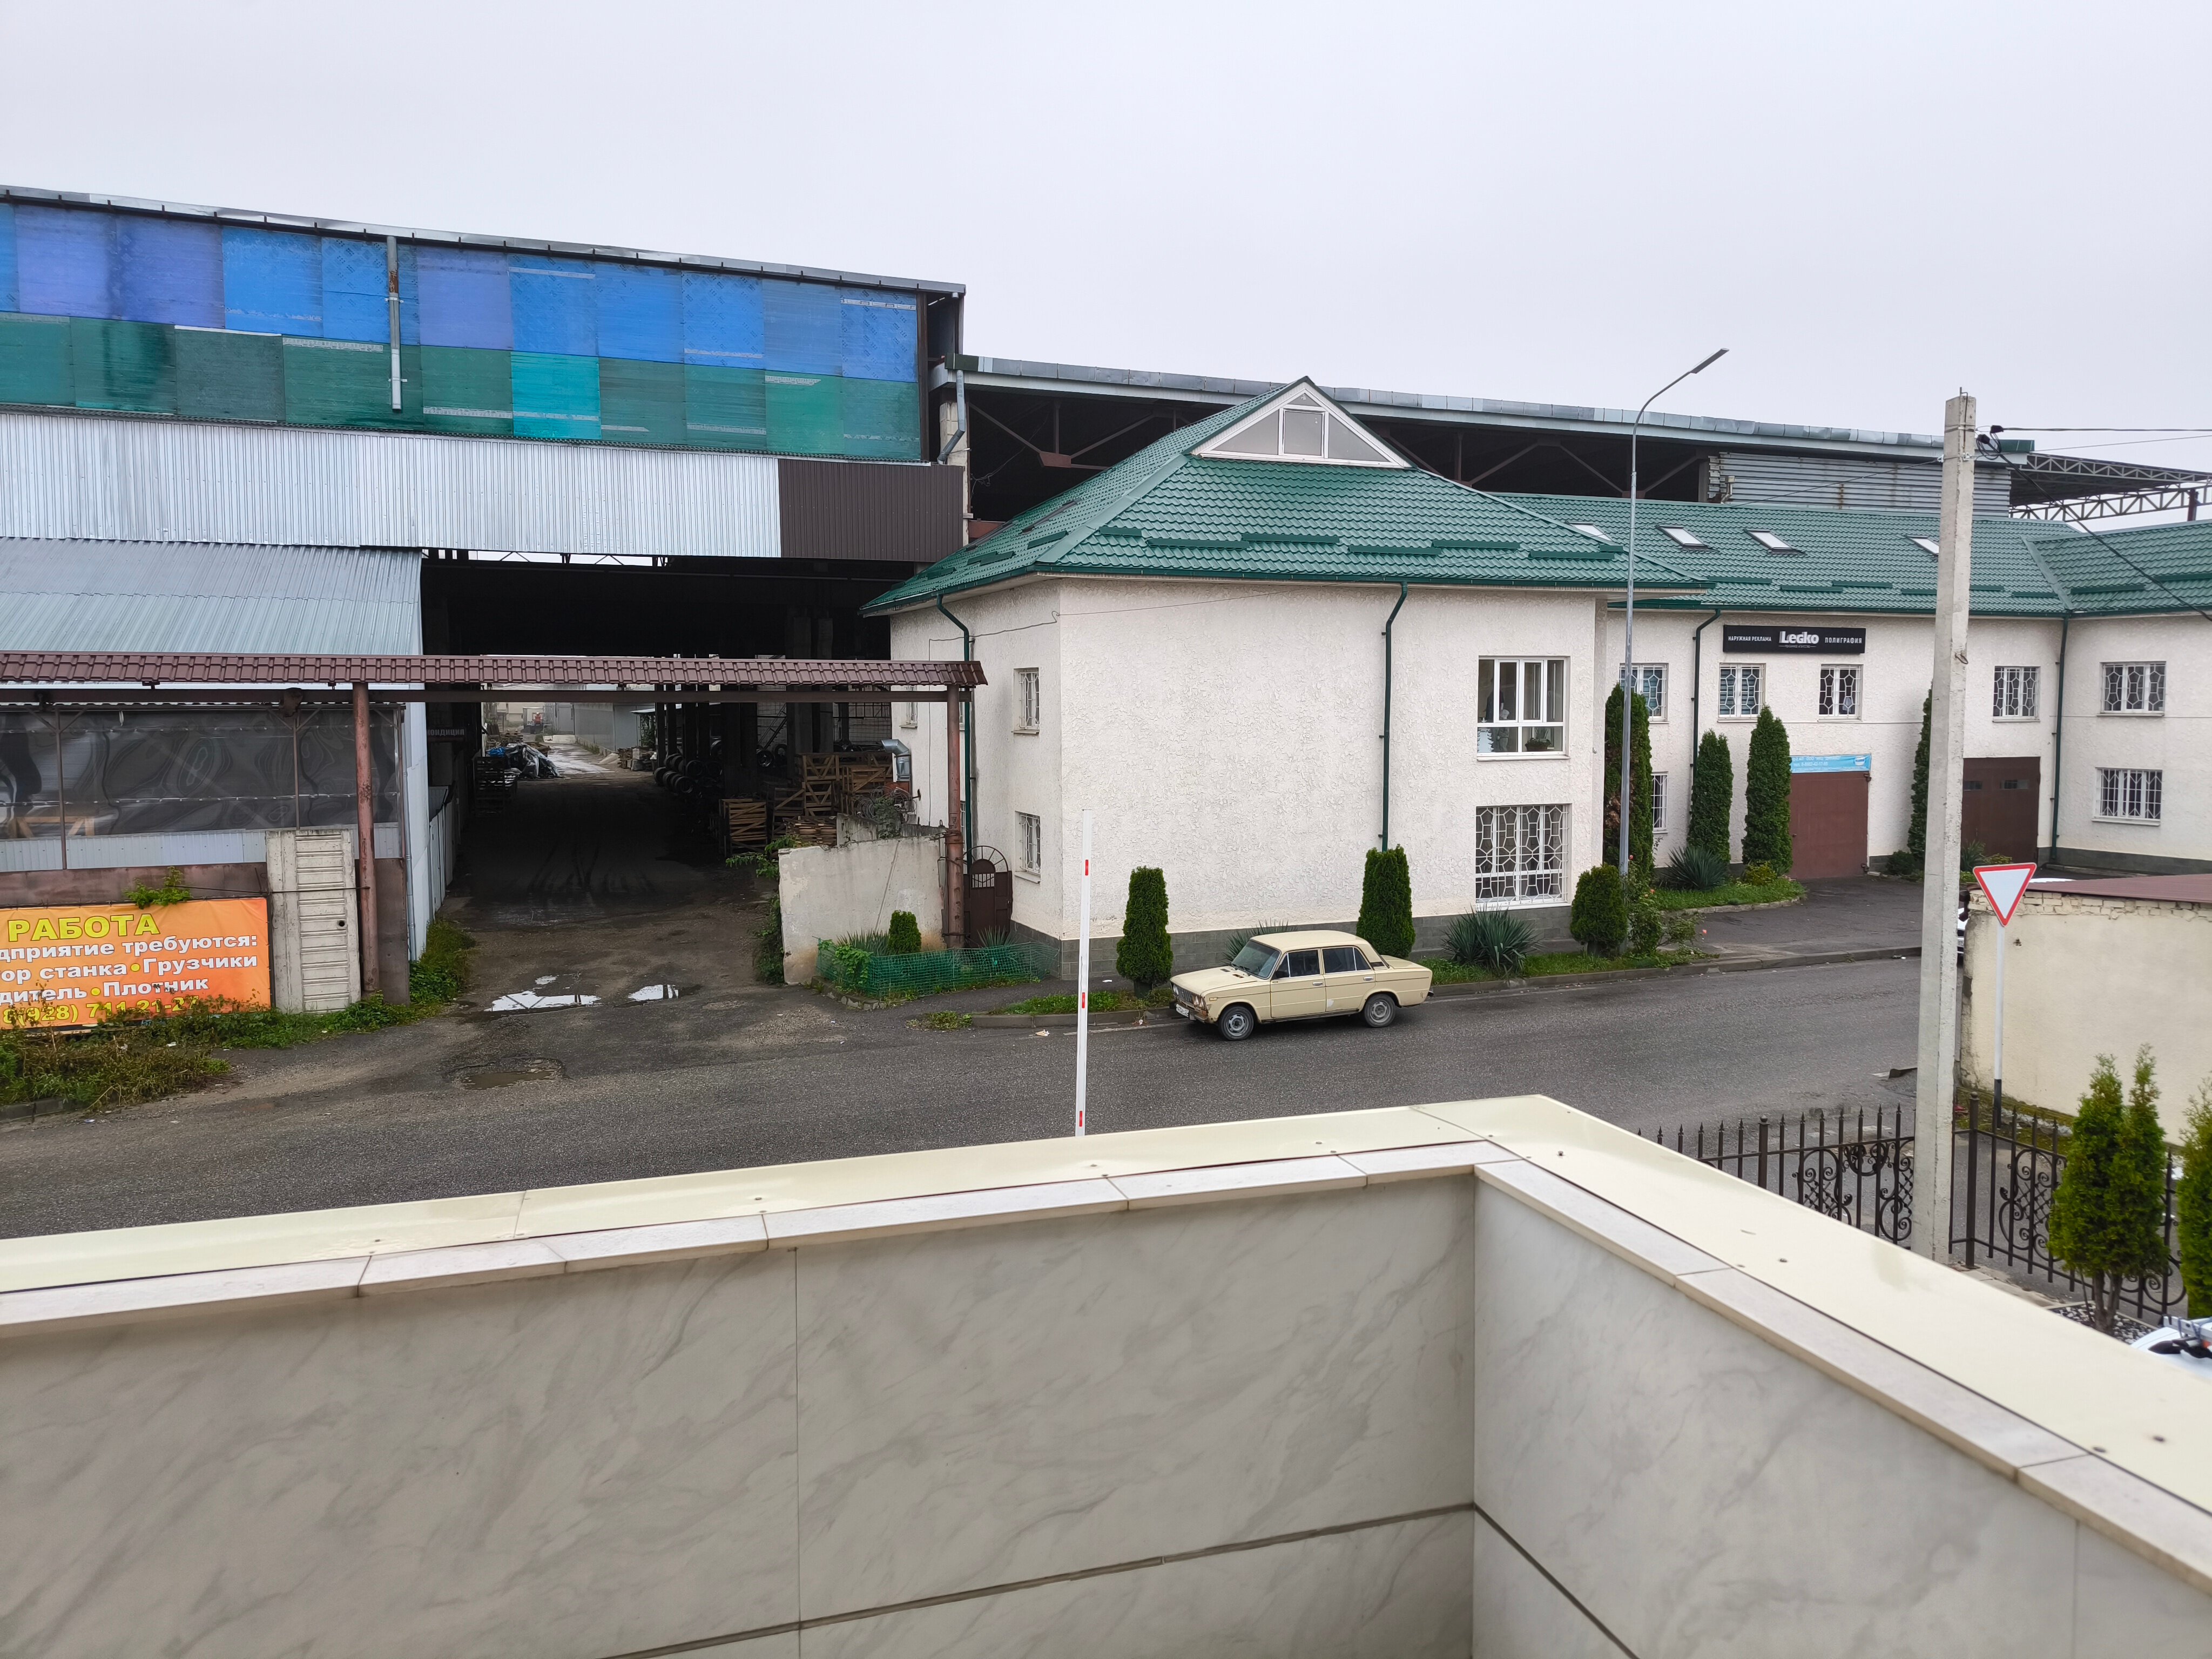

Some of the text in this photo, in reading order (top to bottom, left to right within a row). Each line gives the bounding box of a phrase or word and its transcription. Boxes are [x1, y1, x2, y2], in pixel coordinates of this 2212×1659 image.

[8, 913, 160, 942] РАБОТА
[122, 935, 258, 956] требуются:
[39, 963, 127, 980] станка
[143, 955, 258, 976] Грузчики
[103, 978, 209, 997] Плотник
